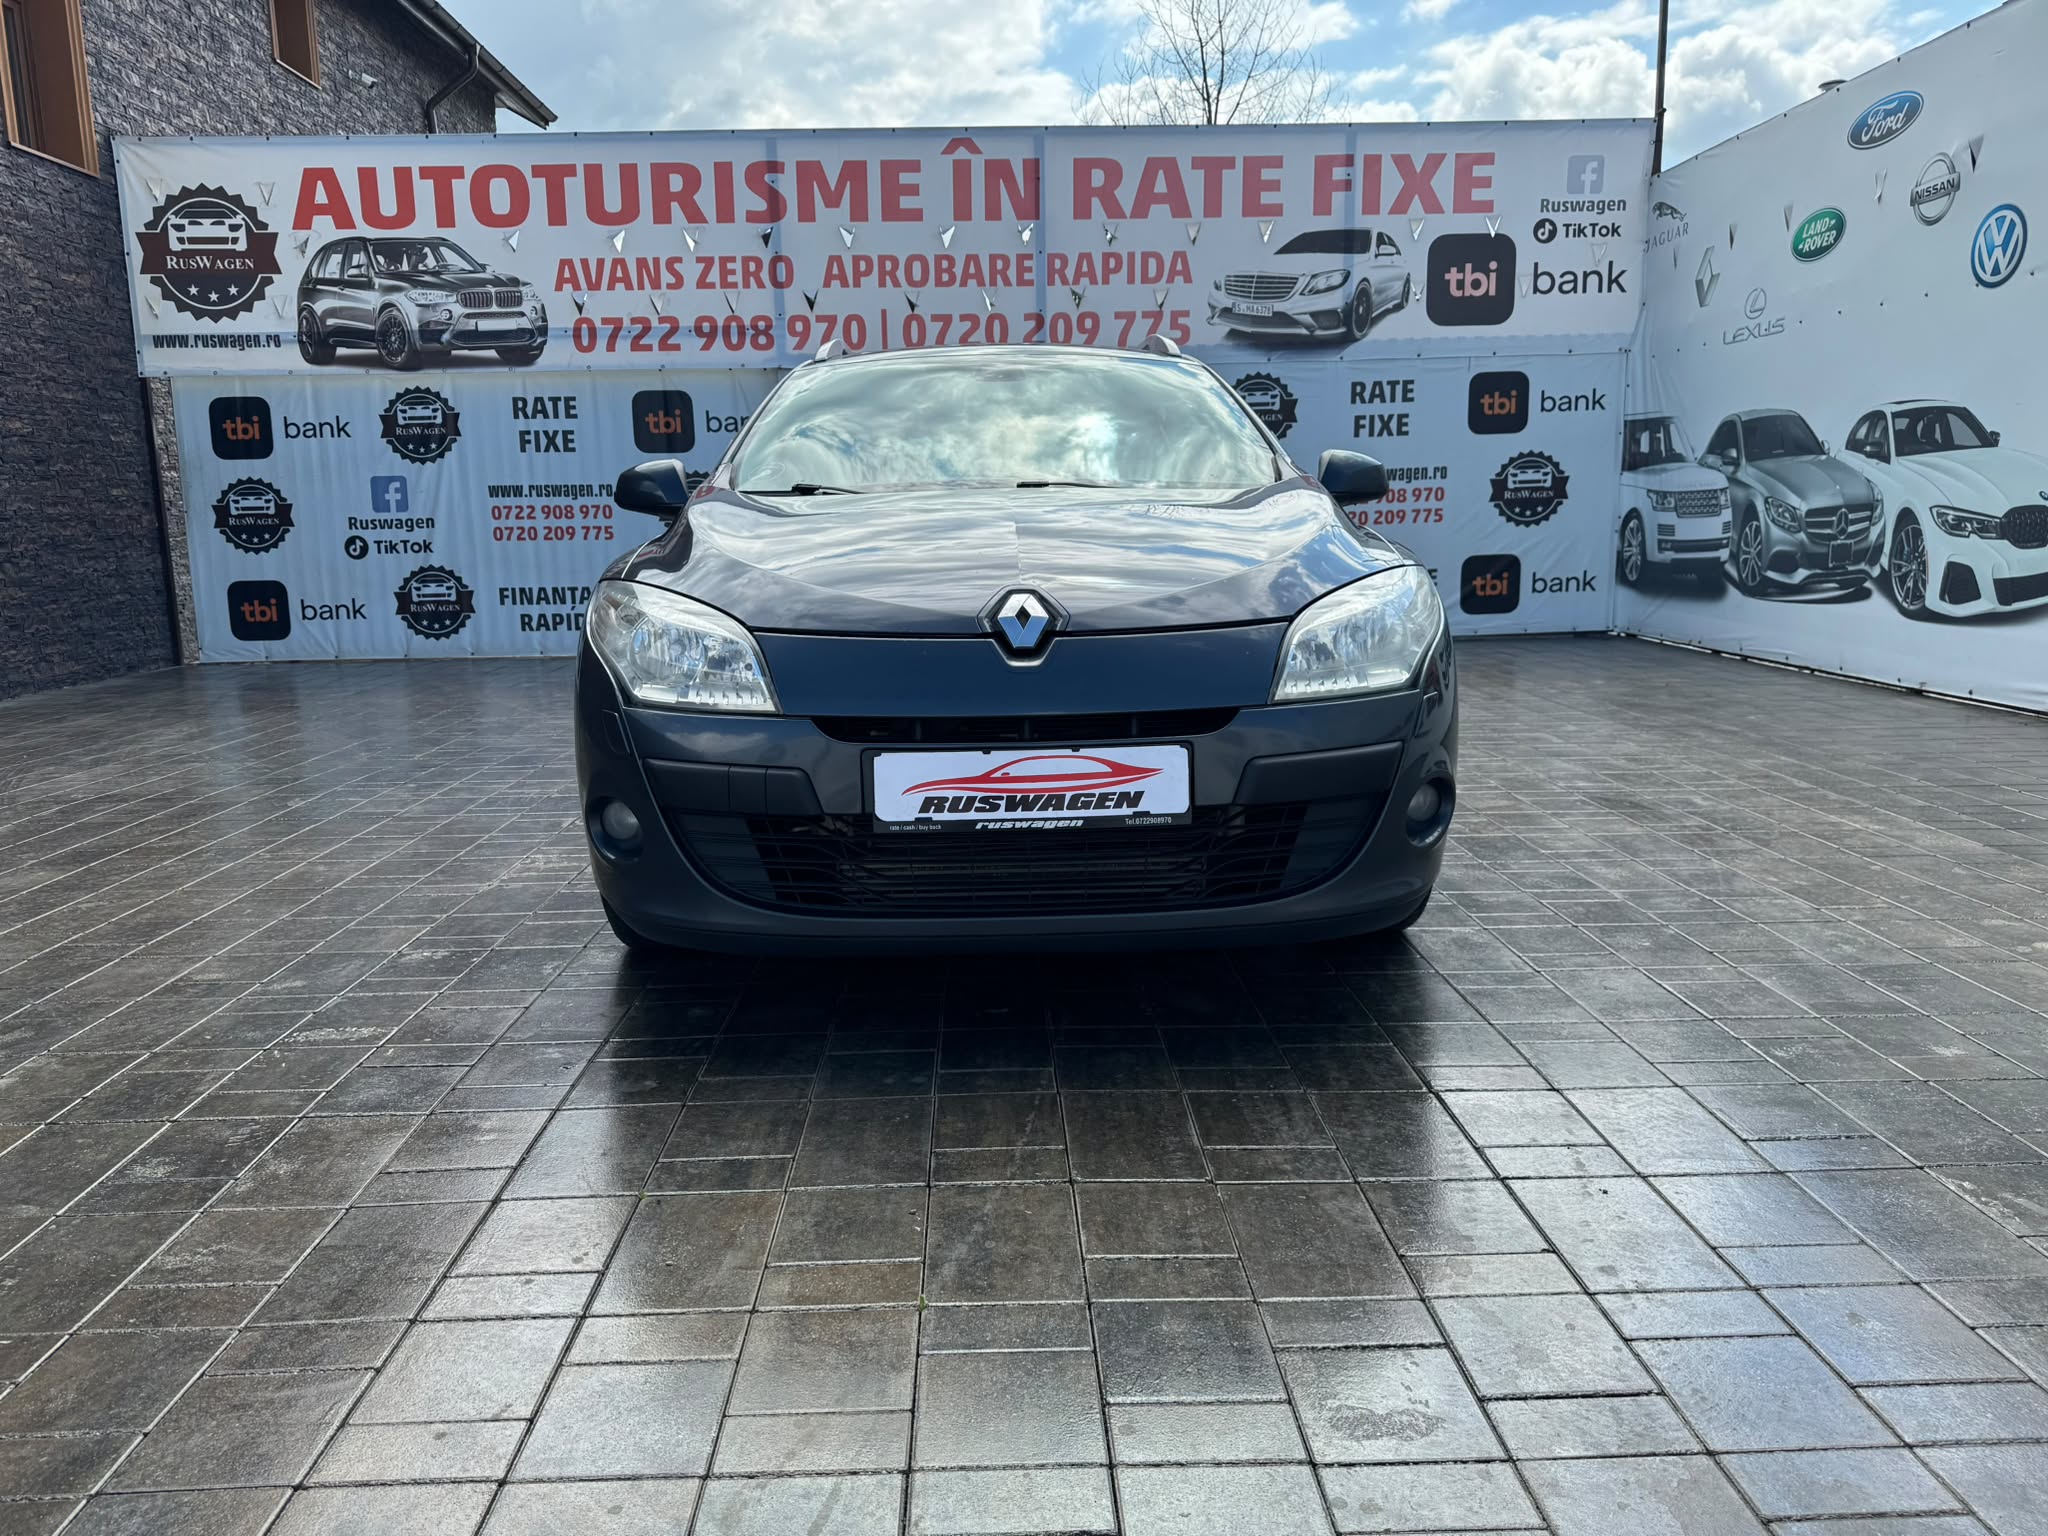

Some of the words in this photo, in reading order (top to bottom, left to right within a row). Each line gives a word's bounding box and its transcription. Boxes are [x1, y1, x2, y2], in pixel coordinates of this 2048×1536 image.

[1861, 99, 1910, 143] Ford
[292, 159, 924, 231] AUTOTURISME
[940, 137, 1040, 221] ÎN
[1072, 155, 1284, 220] RATE
[1312, 152, 1496, 216] FIXE
[1914, 177, 1955, 200] NISSAN
[1539, 198, 1627, 215] Ruswagen
[1562, 222, 1622, 239] TikTok
[1643, 222, 1689, 253] JAGUAR
[1802, 216, 1830, 238] LAND
[1803, 230, 1837, 253] ROVER
[554, 256, 684, 292] AVANS
[695, 255, 795, 290] ZERO
[822, 253, 1034, 290] APROBARE
[1046, 250, 1193, 286] RAPIDA
[1444, 260, 1498, 298] tbi
[1532, 260, 1628, 294] bank
[152, 334, 282, 351] www.ruswagen.ro
[572, 315, 682, 353] 0722
[694, 314, 775, 351] 908
[786, 313, 866, 350] 970
[902, 312, 1009, 349] 0720
[1022, 310, 1101, 346] 209
[1113, 309, 1191, 348] 775
[1722, 316, 1786, 345] LEXUS
[1350, 379, 1415, 404] RATE
[1480, 389, 1518, 416] tbi
[1540, 388, 1606, 412] bank
[511, 396, 578, 419] RATE
[222, 415, 261, 440] tbi
[283, 415, 352, 439] bank
[644, 408, 682, 434] tbi
[1353, 413, 1410, 438] FIXE
[518, 429, 577, 453] FIXE
[487, 483, 614, 500] www.ruswagen.ro
[1411, 486, 1445, 502] 970
[347, 516, 435, 532] Ruswagen
[491, 504, 536, 521] 0722
[541, 504, 575, 520] 908
[579, 504, 613, 519] 970
[1373, 509, 1407, 525] 209
[1411, 508, 1444, 523] 775
[492, 526, 538, 541] 0720
[543, 525, 576, 541] 209
[581, 525, 614, 540] 775
[373, 540, 434, 554] TikTok
[1472, 572, 1509, 597] tbi
[1531, 569, 1597, 594] bank
[240, 598, 278, 623] tbi
[300, 597, 367, 621] bank
[917, 790, 1146, 815] RUSWAGEN
[975, 818, 1085, 831] ruswagen
